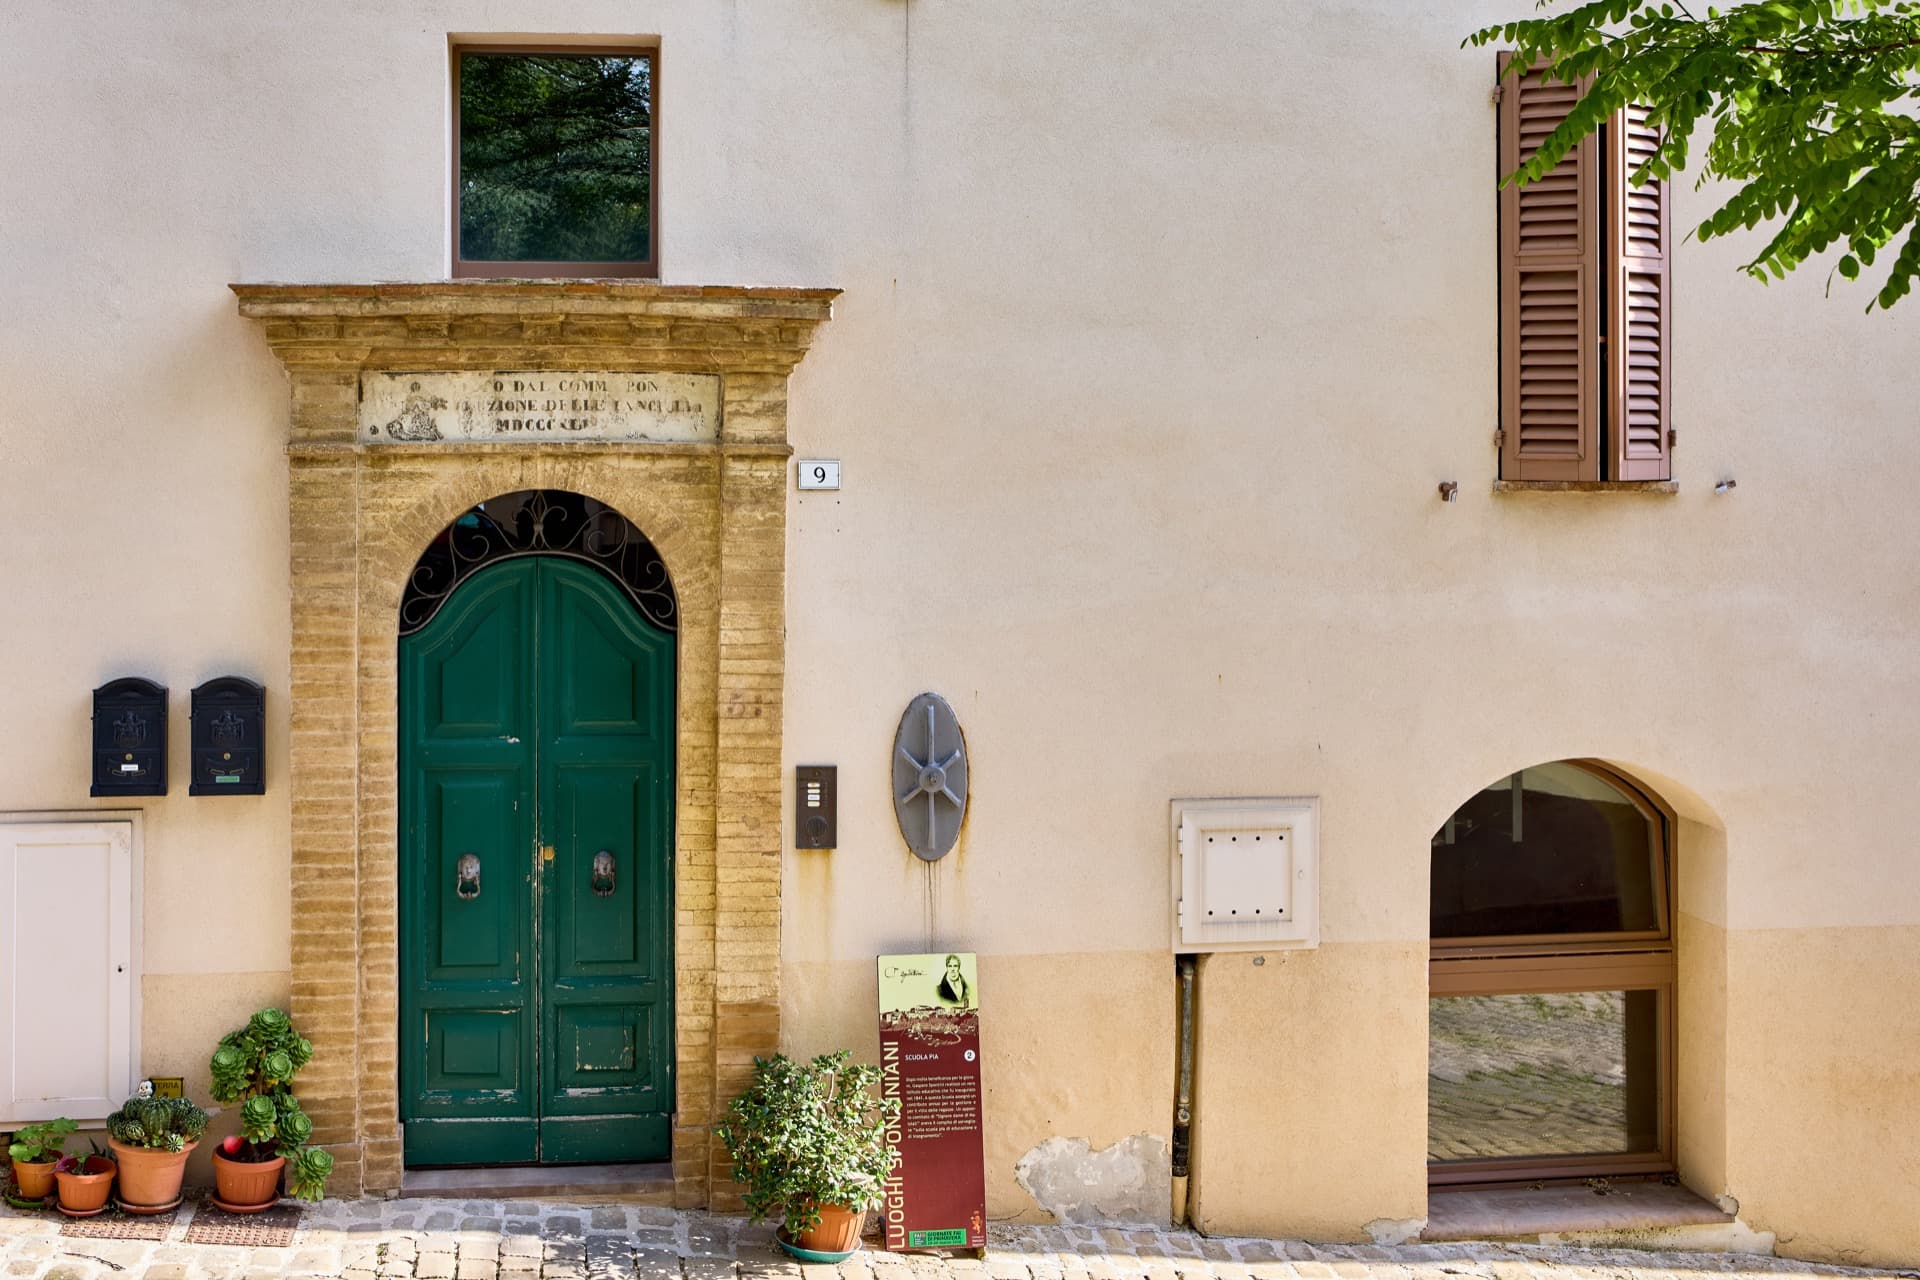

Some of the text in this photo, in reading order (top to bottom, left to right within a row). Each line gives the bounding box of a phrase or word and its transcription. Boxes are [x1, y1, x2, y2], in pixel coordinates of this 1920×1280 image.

[514, 381, 550, 392] DAL
[814, 467, 826, 483] 9
[967, 1051, 972, 1059] 2
[883, 1041, 905, 1249] LUOGHI SPONINIANI
